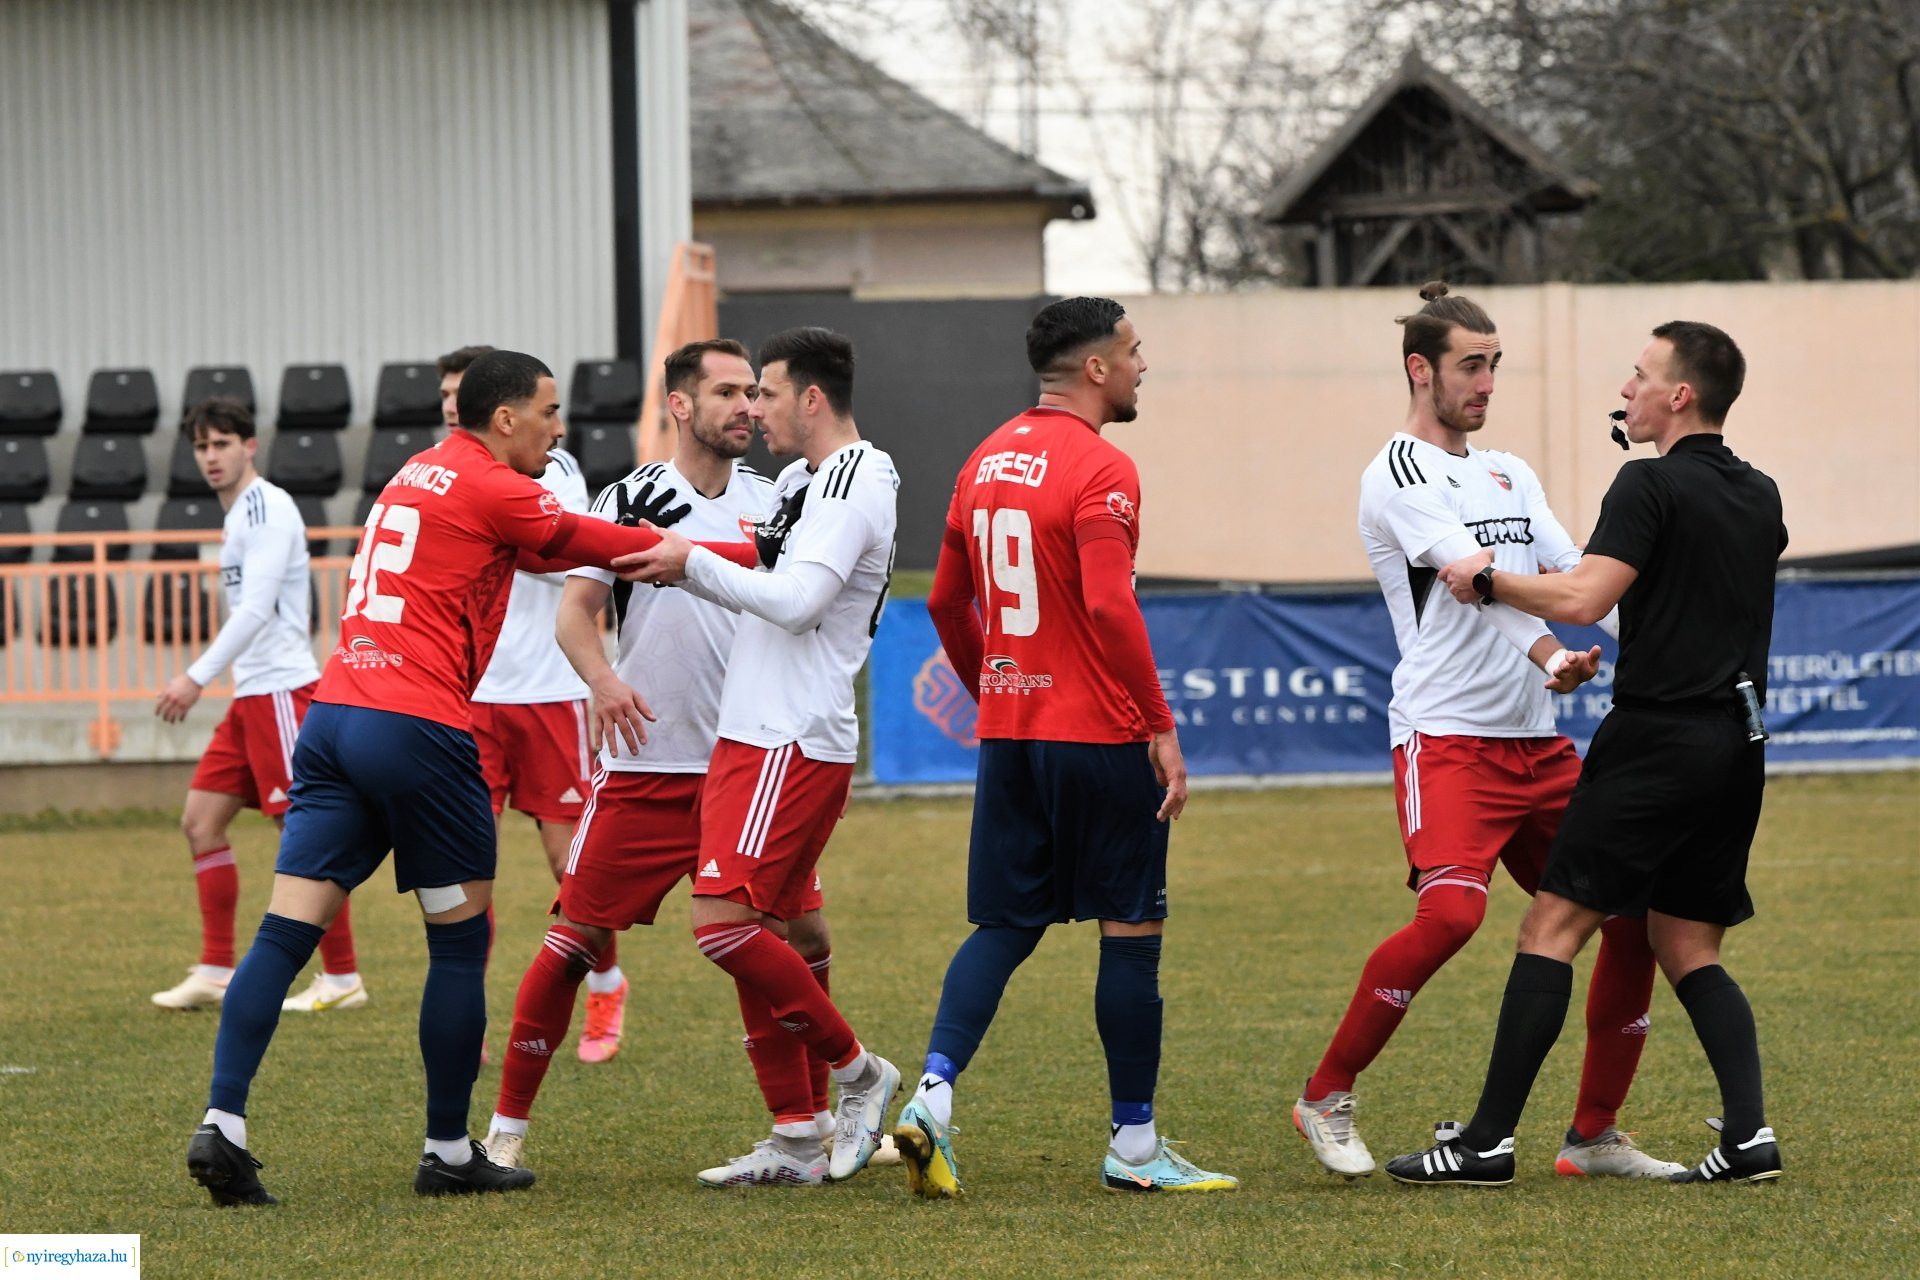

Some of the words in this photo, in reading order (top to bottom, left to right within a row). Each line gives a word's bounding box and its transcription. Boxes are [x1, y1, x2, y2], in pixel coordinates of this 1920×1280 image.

[975, 450, 1049, 488] GRESÓ
[972, 507, 1040, 637] 19
[1158, 666, 1367, 700] ESTIGE
[1766, 684, 1869, 714] TÉTTEL
[1231, 704, 1368, 725] CENTER
